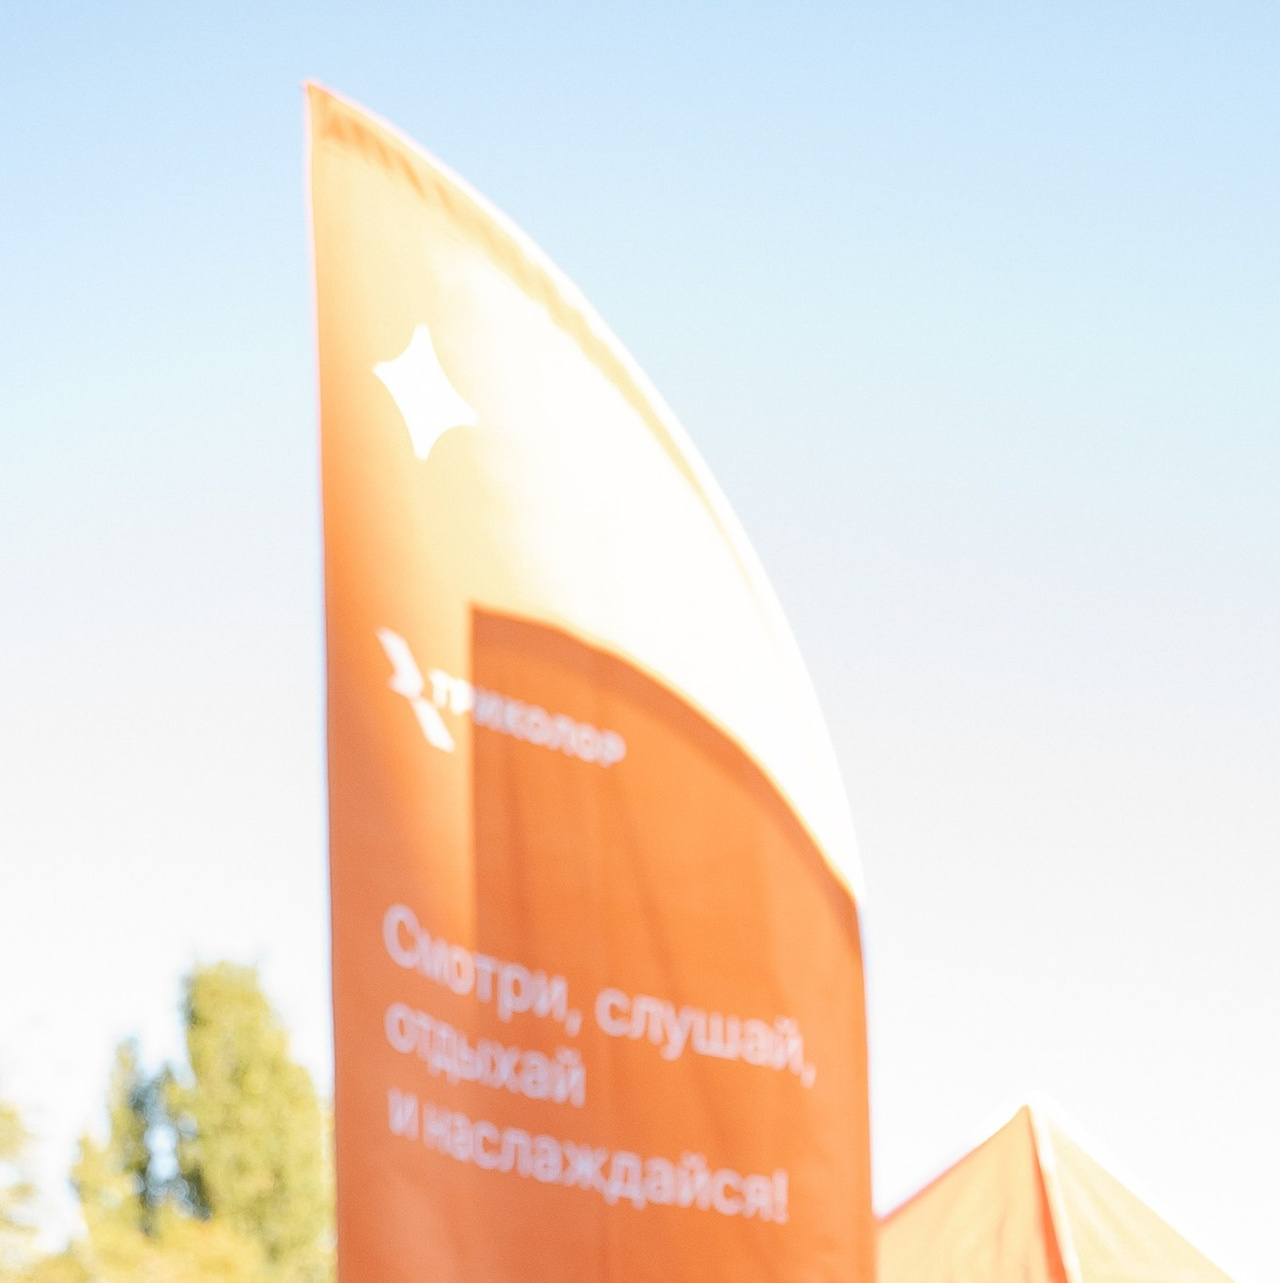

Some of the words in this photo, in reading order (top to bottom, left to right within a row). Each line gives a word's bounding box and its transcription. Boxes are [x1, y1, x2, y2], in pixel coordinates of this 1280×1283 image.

[383, 904, 581, 1036] Смотри,
[594, 987, 814, 1087] слушай,
[384, 1003, 585, 1105] отдыхай
[386, 1088, 420, 1139] и
[423, 1102, 789, 1224] наслаждайся!
